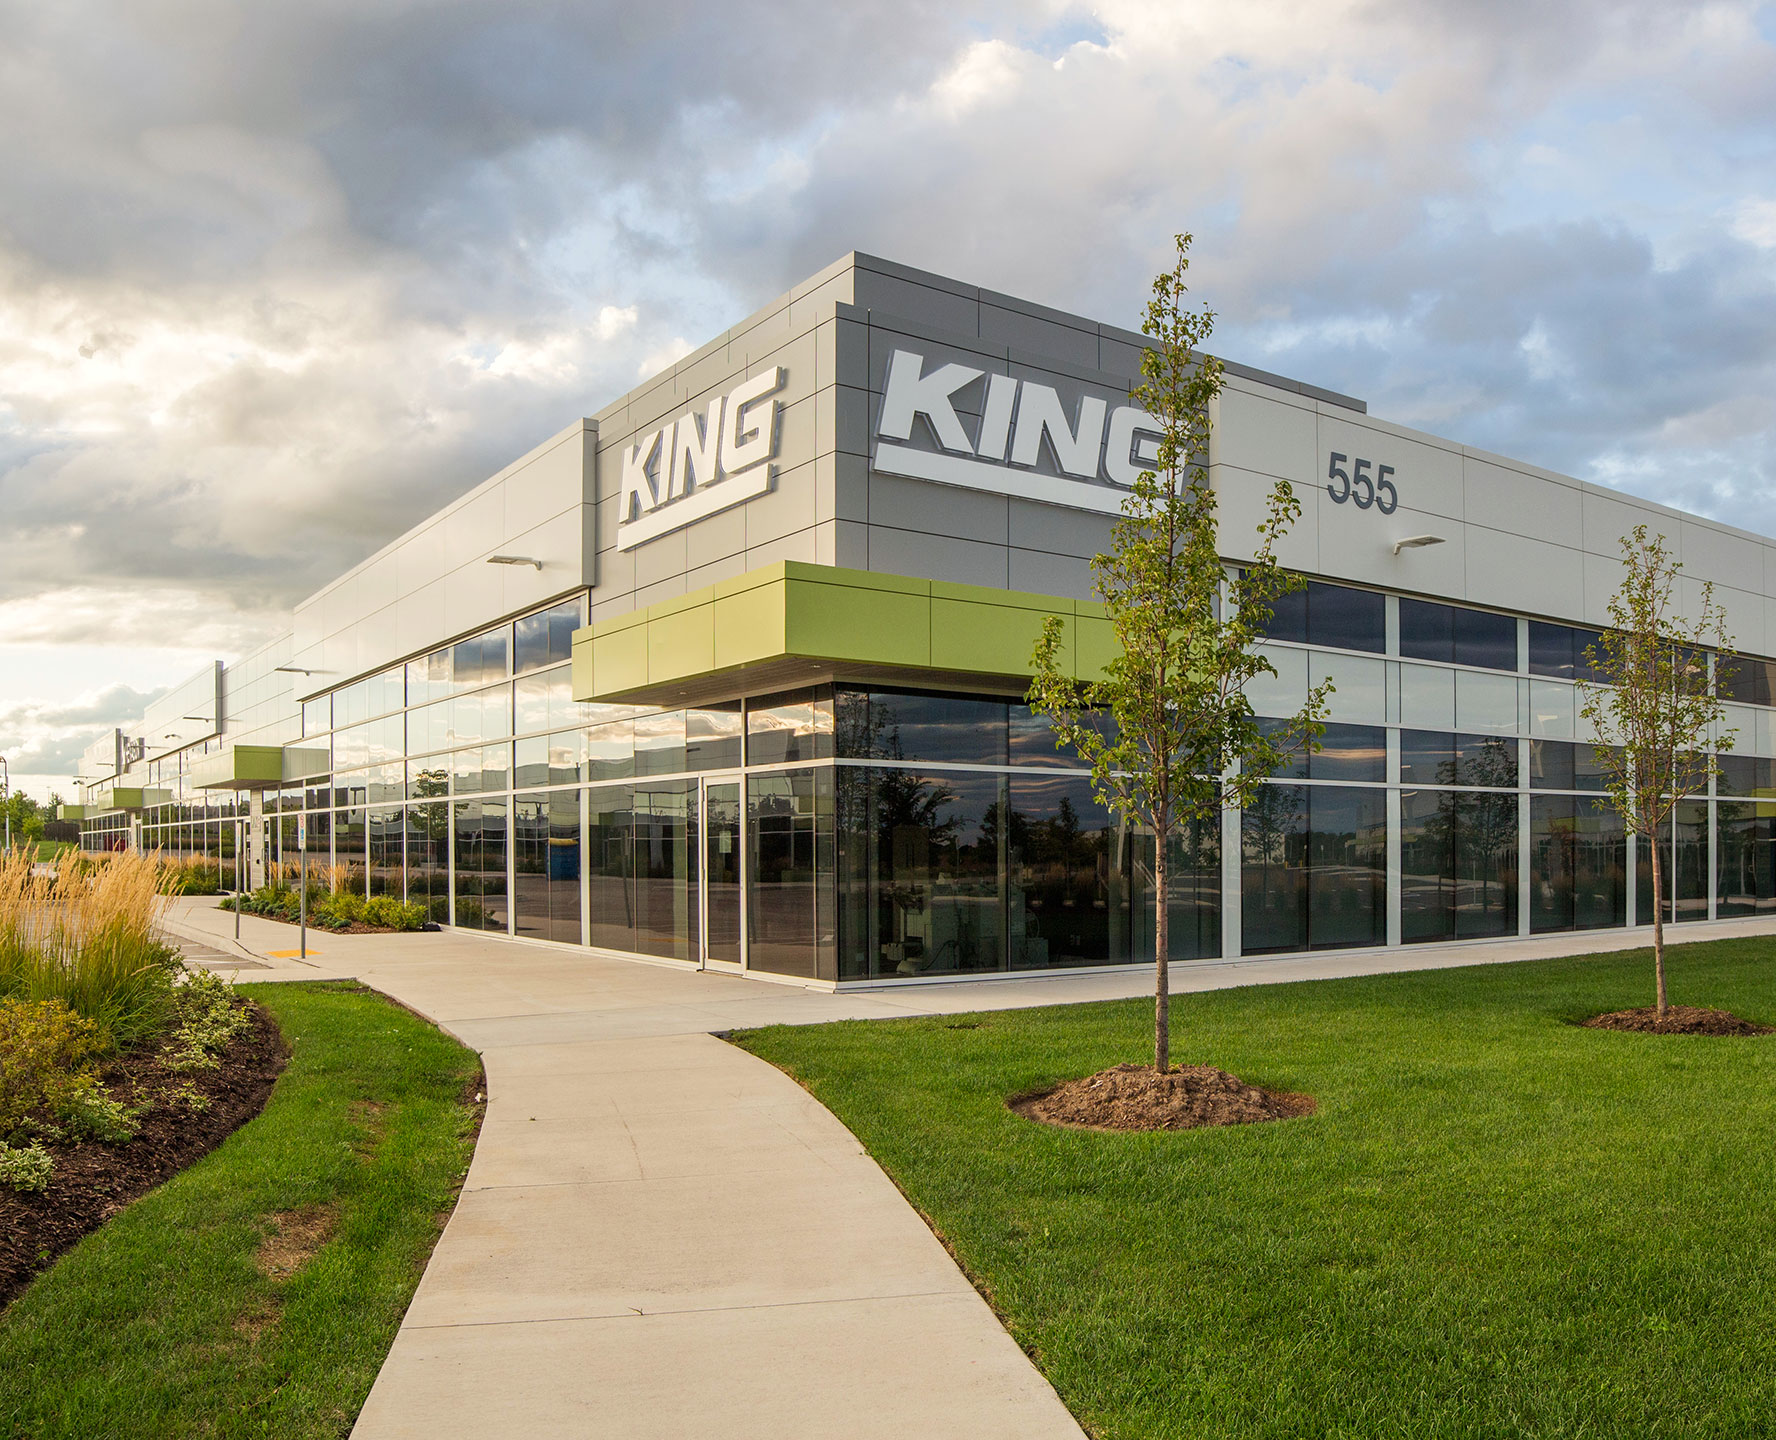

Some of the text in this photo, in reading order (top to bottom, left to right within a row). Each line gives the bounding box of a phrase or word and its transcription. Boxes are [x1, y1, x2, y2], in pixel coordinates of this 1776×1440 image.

[618, 366, 785, 524] KING
[876, 349, 1191, 496] KING
[1327, 451, 1397, 515] 555
